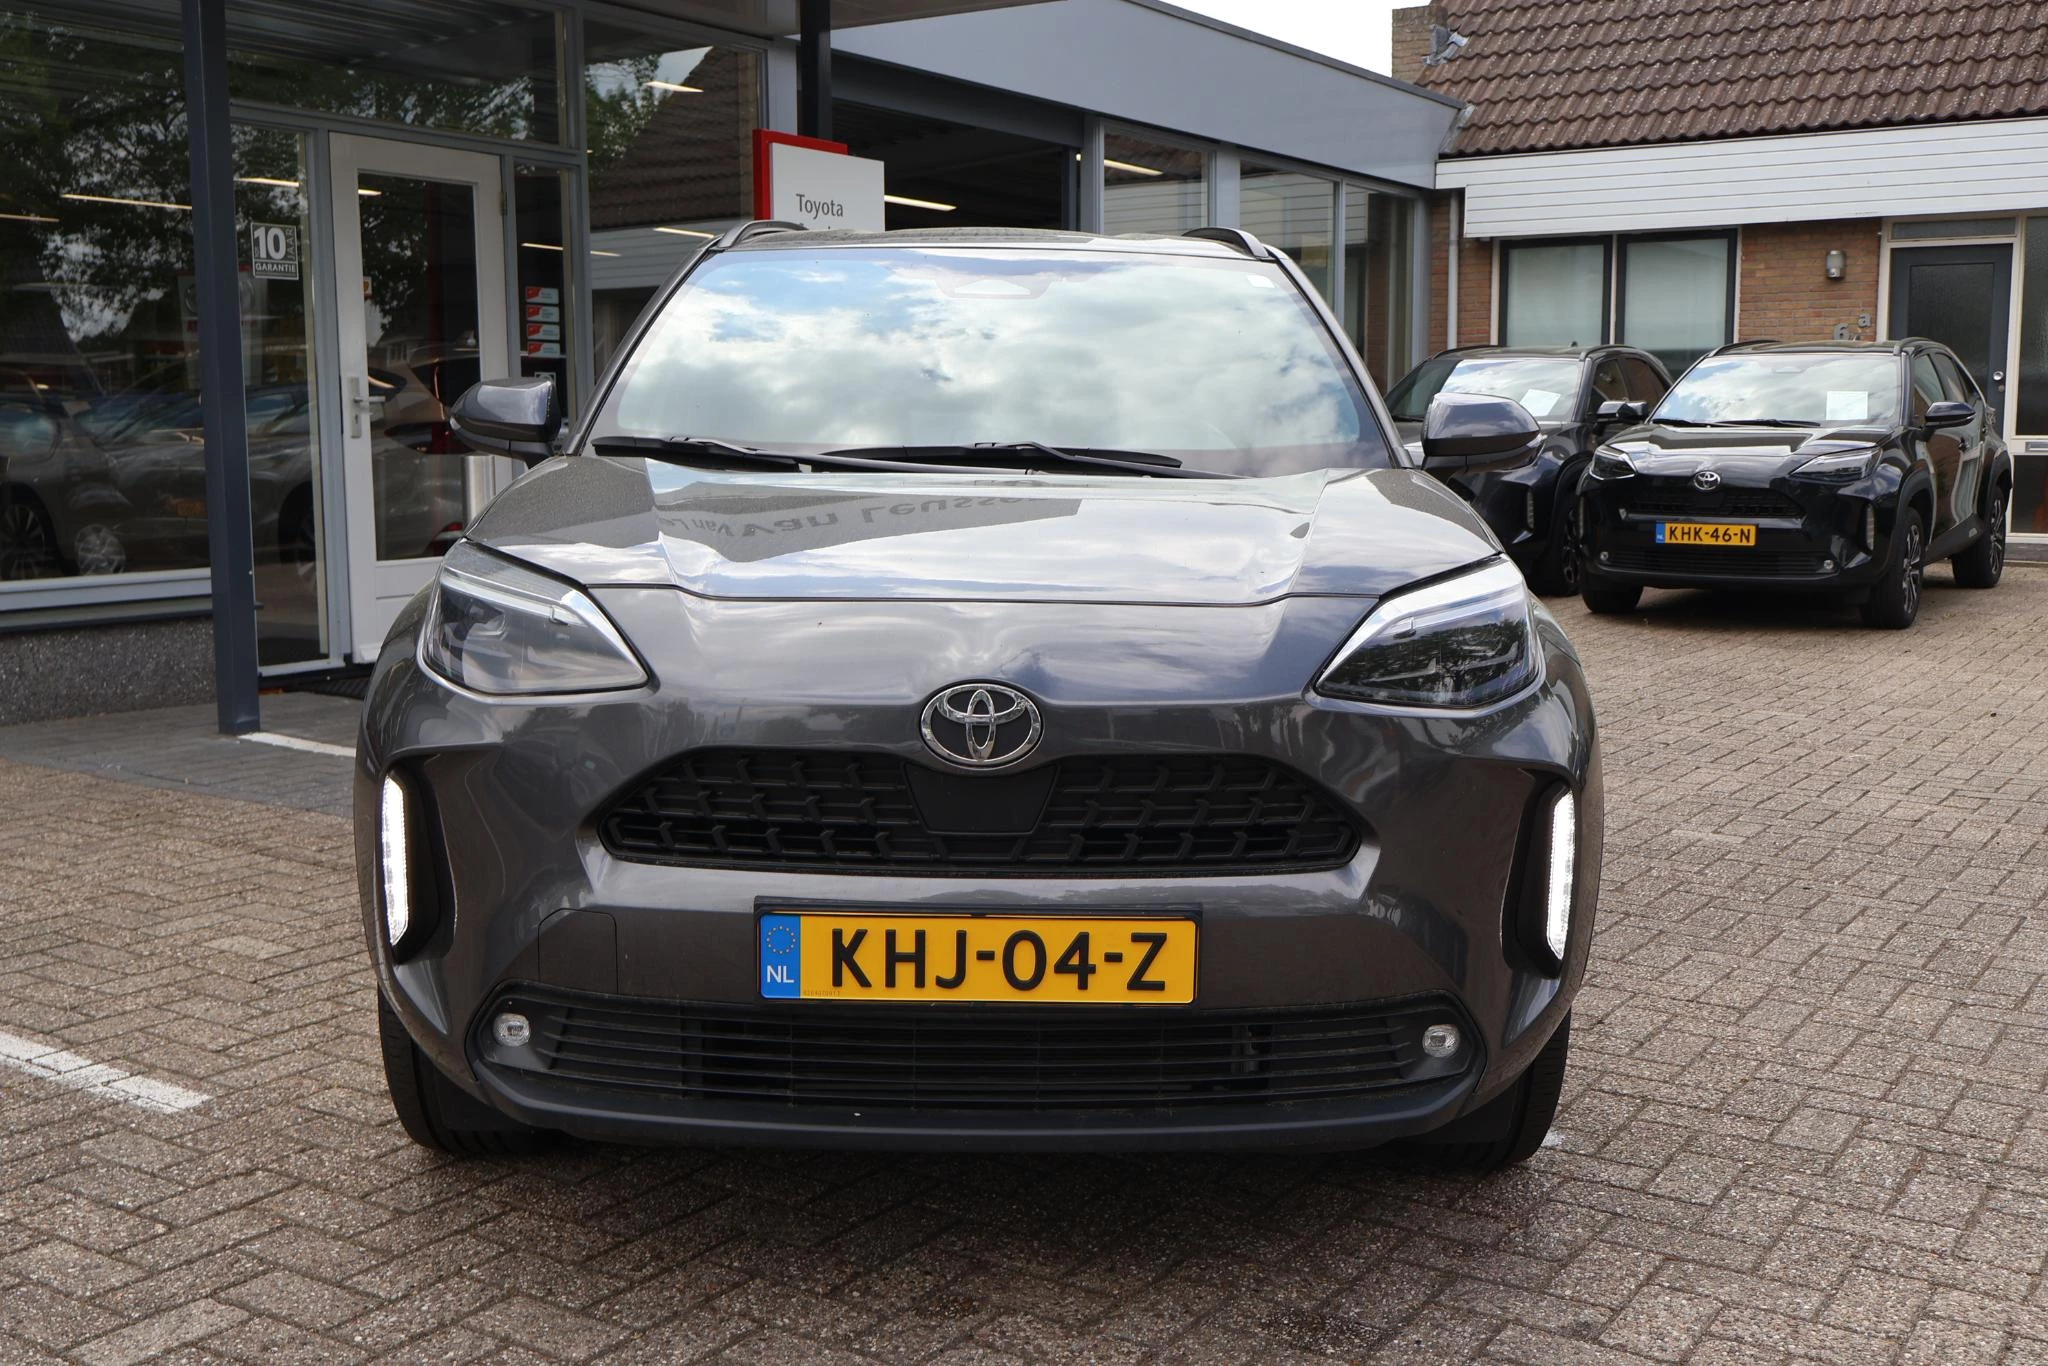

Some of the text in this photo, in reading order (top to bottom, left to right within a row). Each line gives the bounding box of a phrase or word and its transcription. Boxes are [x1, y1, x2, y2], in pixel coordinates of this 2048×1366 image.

[796, 193, 844, 219] Toyota
[254, 226, 286, 259] 10
[255, 263, 296, 272] GARANTIE
[1669, 525, 1751, 543] KHK-46-N
[831, 928, 1168, 992] KHJ-04-Z
[766, 965, 795, 984] NL
